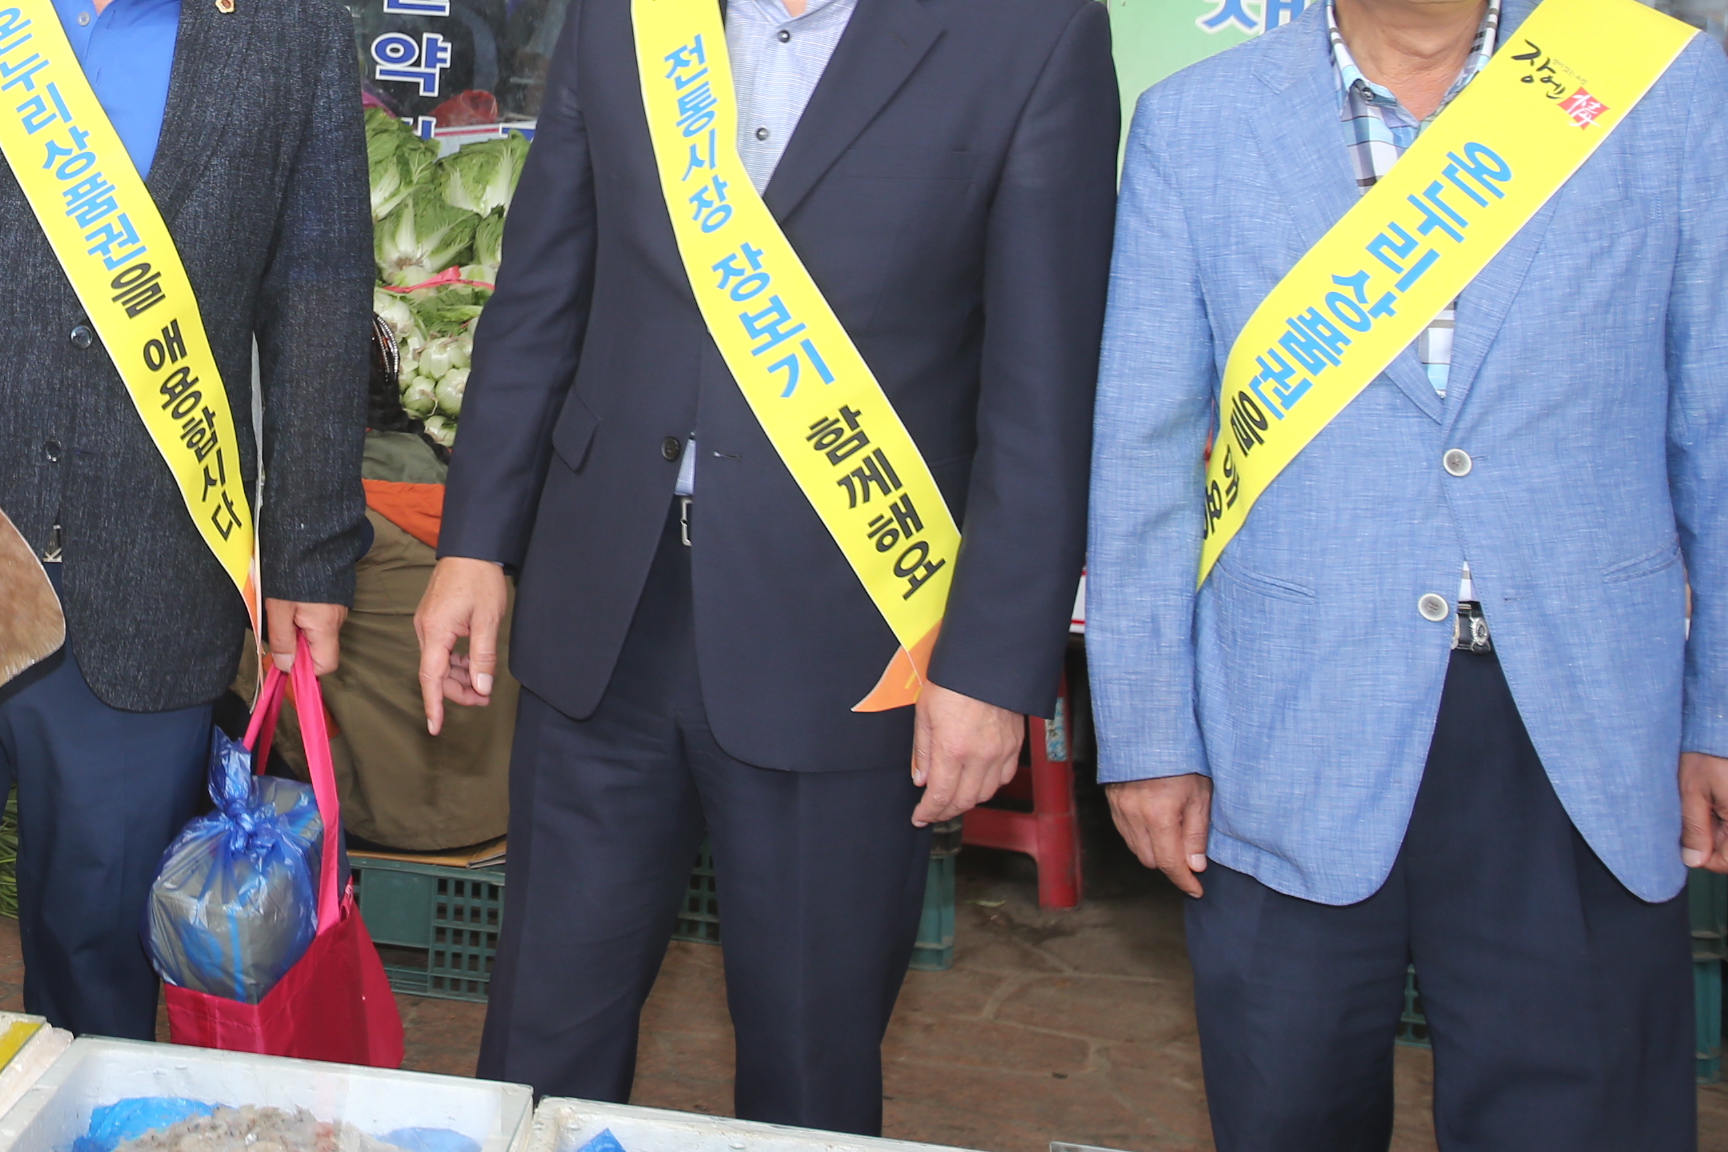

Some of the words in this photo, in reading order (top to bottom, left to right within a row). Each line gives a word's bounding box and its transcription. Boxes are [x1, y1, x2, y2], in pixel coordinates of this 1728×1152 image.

[142, 318, 244, 542] 애용합시다
[663, 32, 733, 235] 전통시장
[711, 241, 836, 398] 장보기
[805, 404, 947, 601] 함께해요
